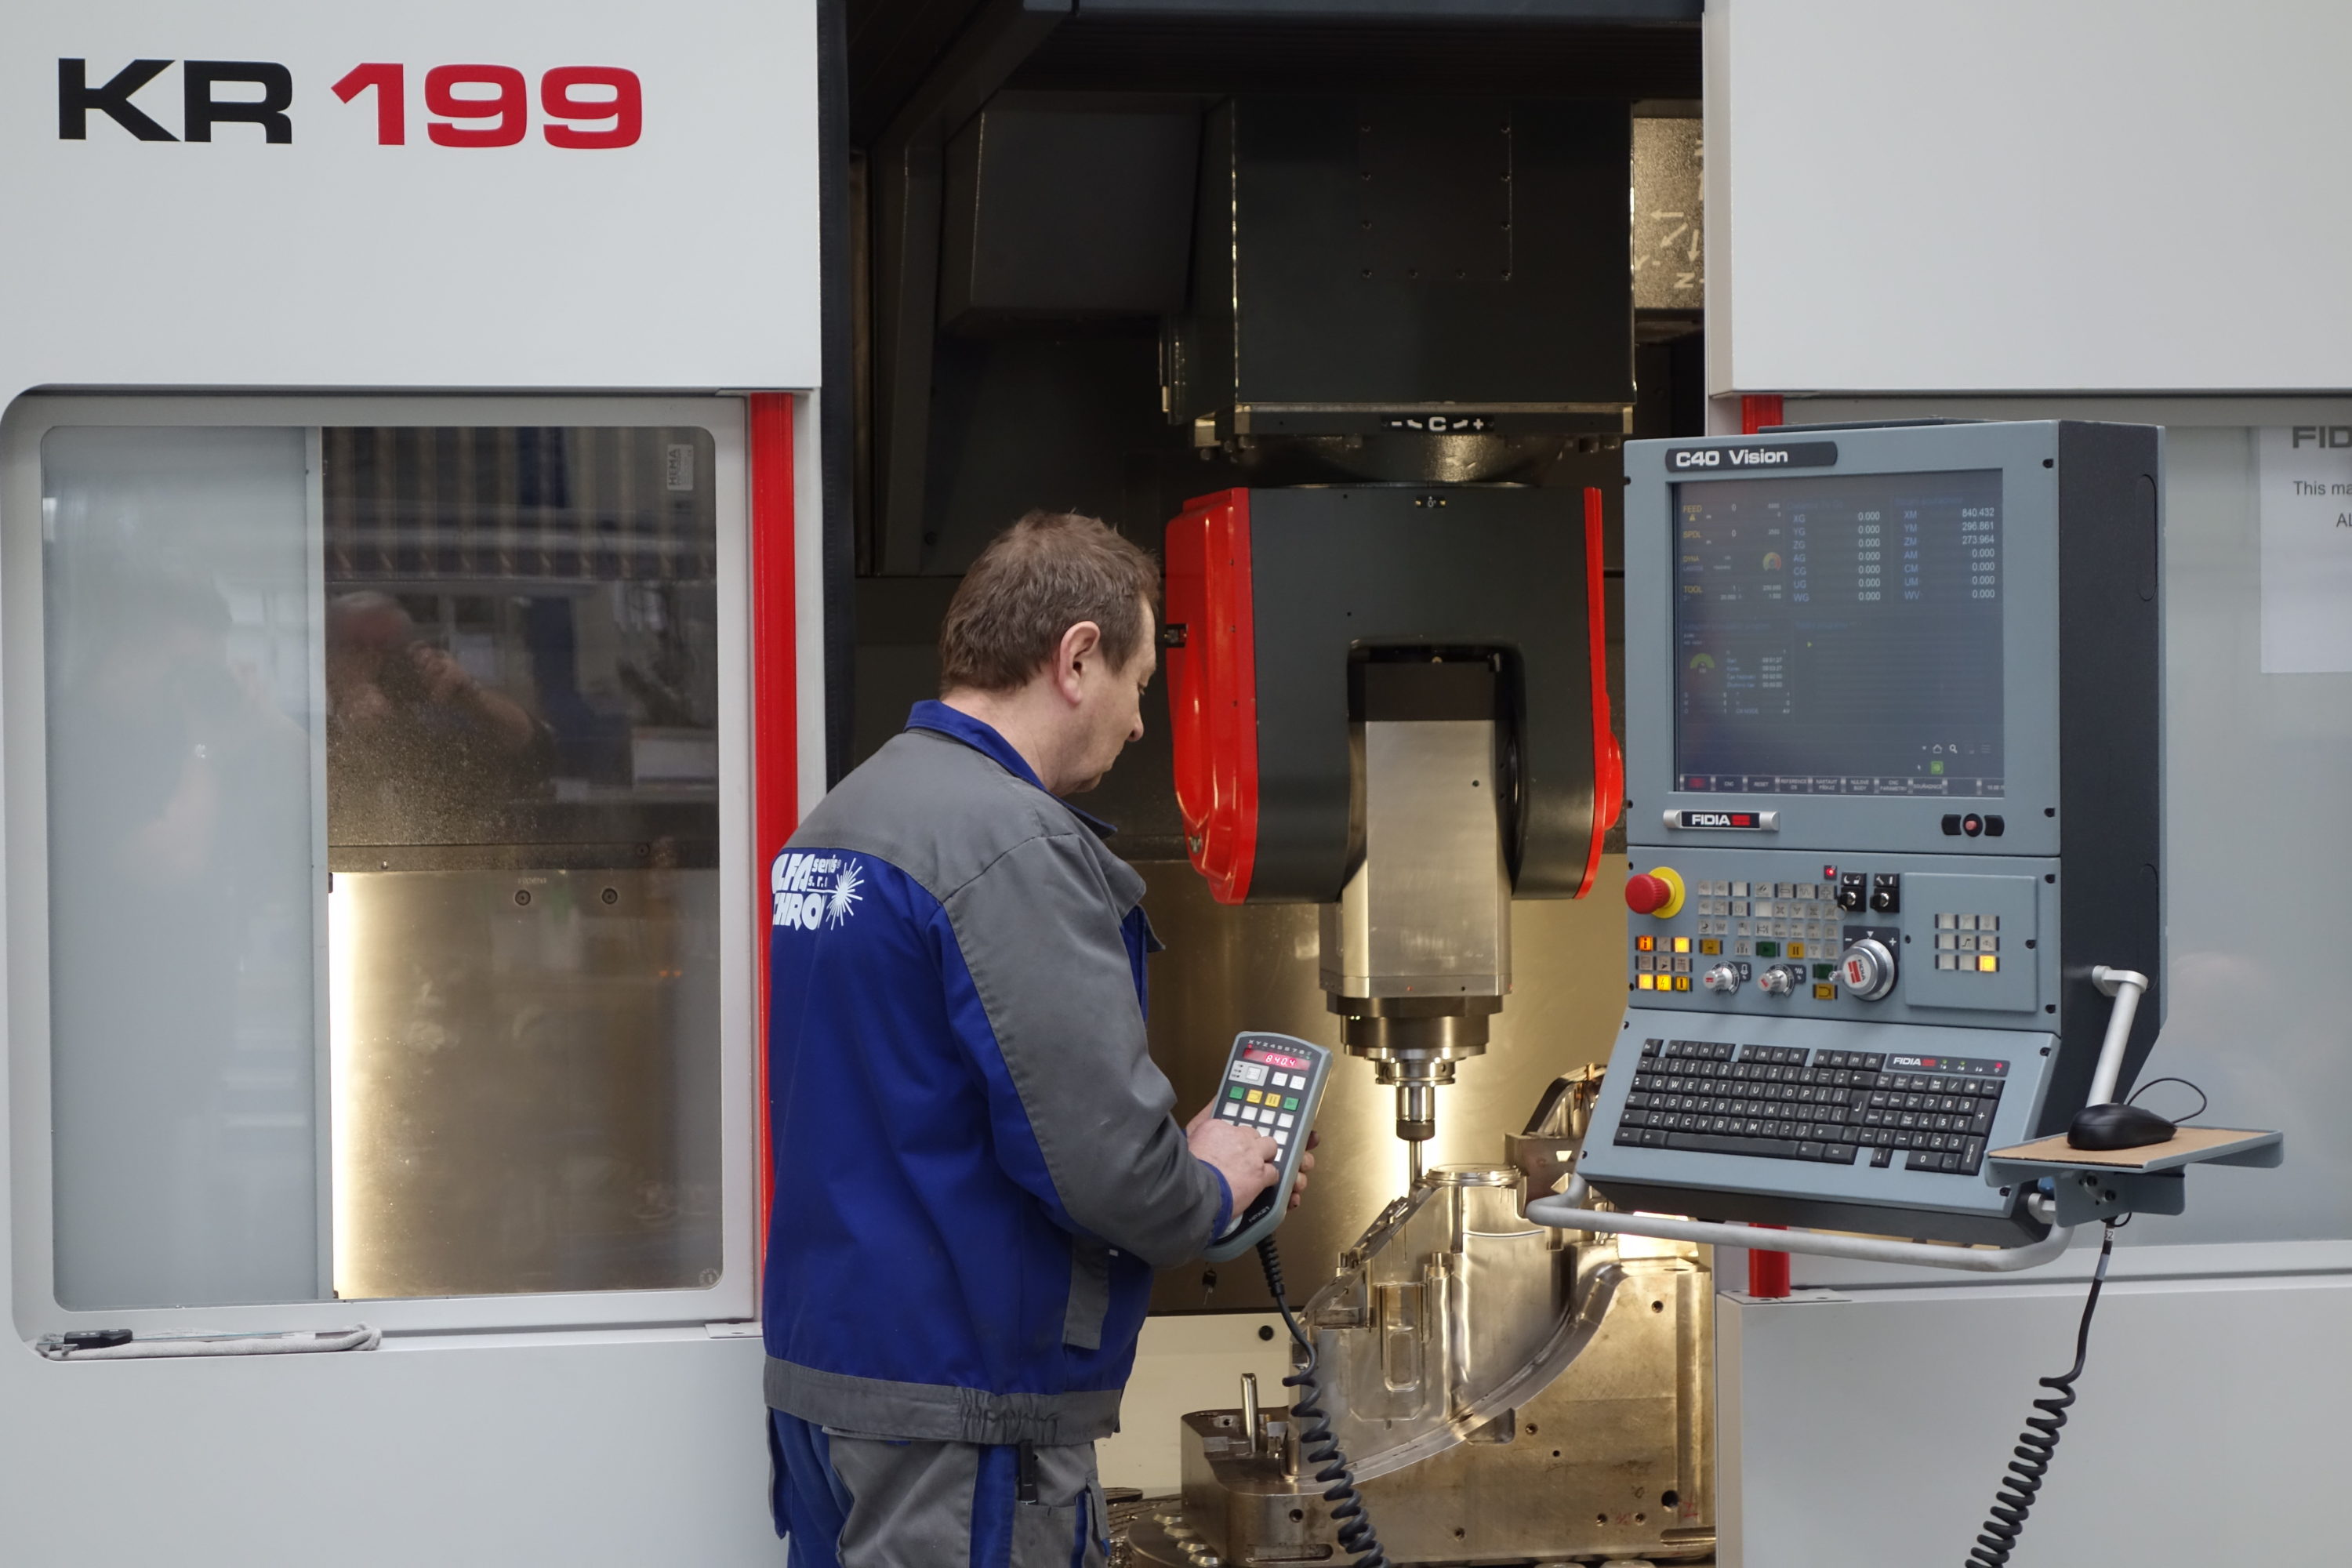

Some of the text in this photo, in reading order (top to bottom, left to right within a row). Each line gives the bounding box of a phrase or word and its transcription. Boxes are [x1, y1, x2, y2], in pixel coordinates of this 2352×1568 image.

[58, 57, 643, 149] KR 199
[1428, 416, 1446, 431] C
[1676, 448, 1788, 467] C40 Vision
[2293, 480, 2326, 495] This
[1682, 505, 1703, 514] FEED
[1793, 511, 1881, 523] XG 0.000
[1793, 525, 1881, 536] YG 0.000
[1857, 539, 1881, 547] 0.000
[1793, 552, 1881, 562] AG 0.000
[1972, 549, 1995, 557] 0.000
[1793, 564, 1881, 575] CG 0.000
[1972, 562, 1995, 571] 0.000
[1793, 579, 1881, 588] UG 0.000
[1972, 575, 1995, 585] 0.000
[1684, 585, 1702, 593] TOOL
[1972, 590, 1995, 598] 0.000
[1793, 591, 1881, 601] WG 0.000
[1692, 814, 1730, 826] FIDIA
[1857, 959, 1866, 981] FIDIA
[1265, 1054, 1296, 1066] 840.4
[1893, 1057, 1922, 1066] FIDIA
